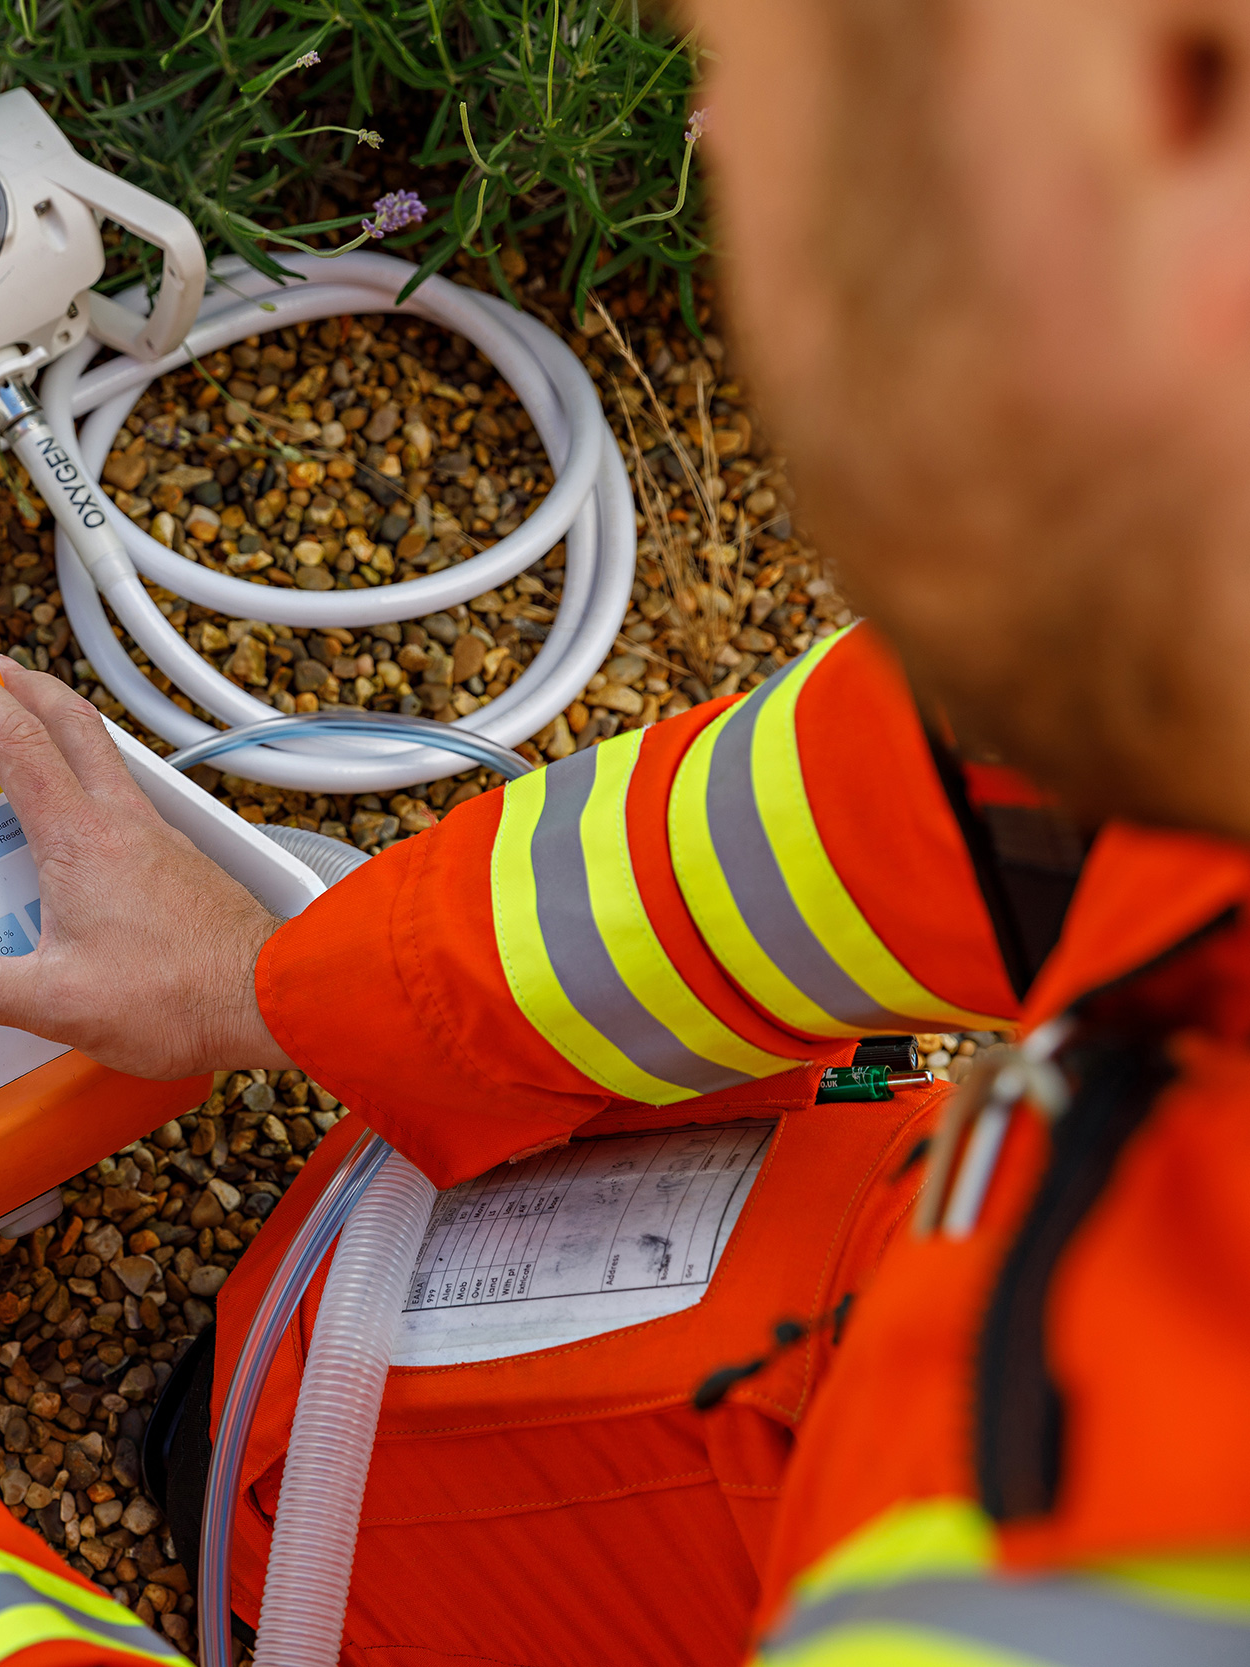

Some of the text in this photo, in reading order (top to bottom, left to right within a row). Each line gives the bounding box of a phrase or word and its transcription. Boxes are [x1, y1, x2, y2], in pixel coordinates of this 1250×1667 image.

[37, 437, 105, 529] OXYGEN
[2, 930, 15, 940] %
[0, 945, 15, 957] O2
[474, 1202, 487, 1219] Move
[503, 1201, 515, 1215] Land
[517, 1263, 532, 1295] Extricate
[606, 1254, 620, 1285] Address
[685, 1263, 694, 1278] Grid
[412, 1282, 425, 1305] EAAA
[427, 1289, 437, 1303] 999
[456, 1281, 467, 1301] Mob
[471, 1279, 483, 1299] Over
[486, 1277, 498, 1298] Land
[502, 1278, 513, 1296] With
